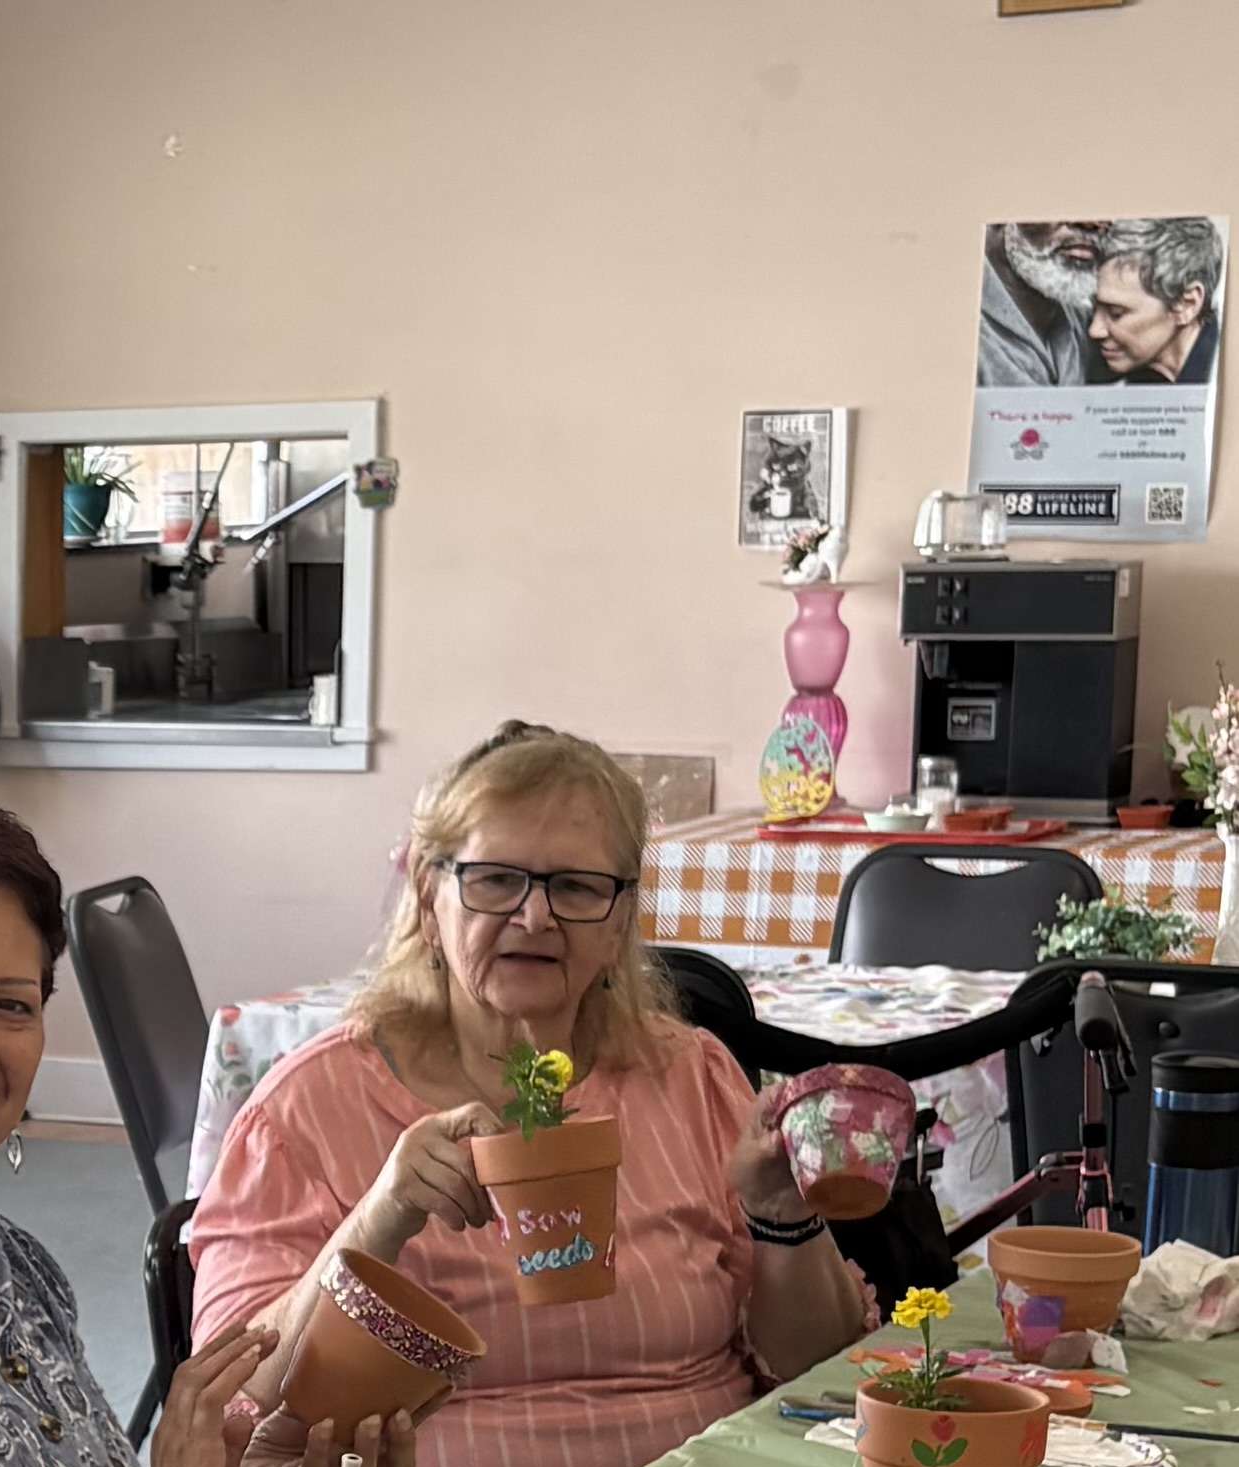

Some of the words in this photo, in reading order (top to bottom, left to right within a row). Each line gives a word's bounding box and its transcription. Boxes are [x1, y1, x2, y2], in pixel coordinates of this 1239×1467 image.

[763, 415, 816, 433] COFFEE
[1002, 493, 1033, 514] 88
[1036, 503, 1106, 515] LIFELINE
